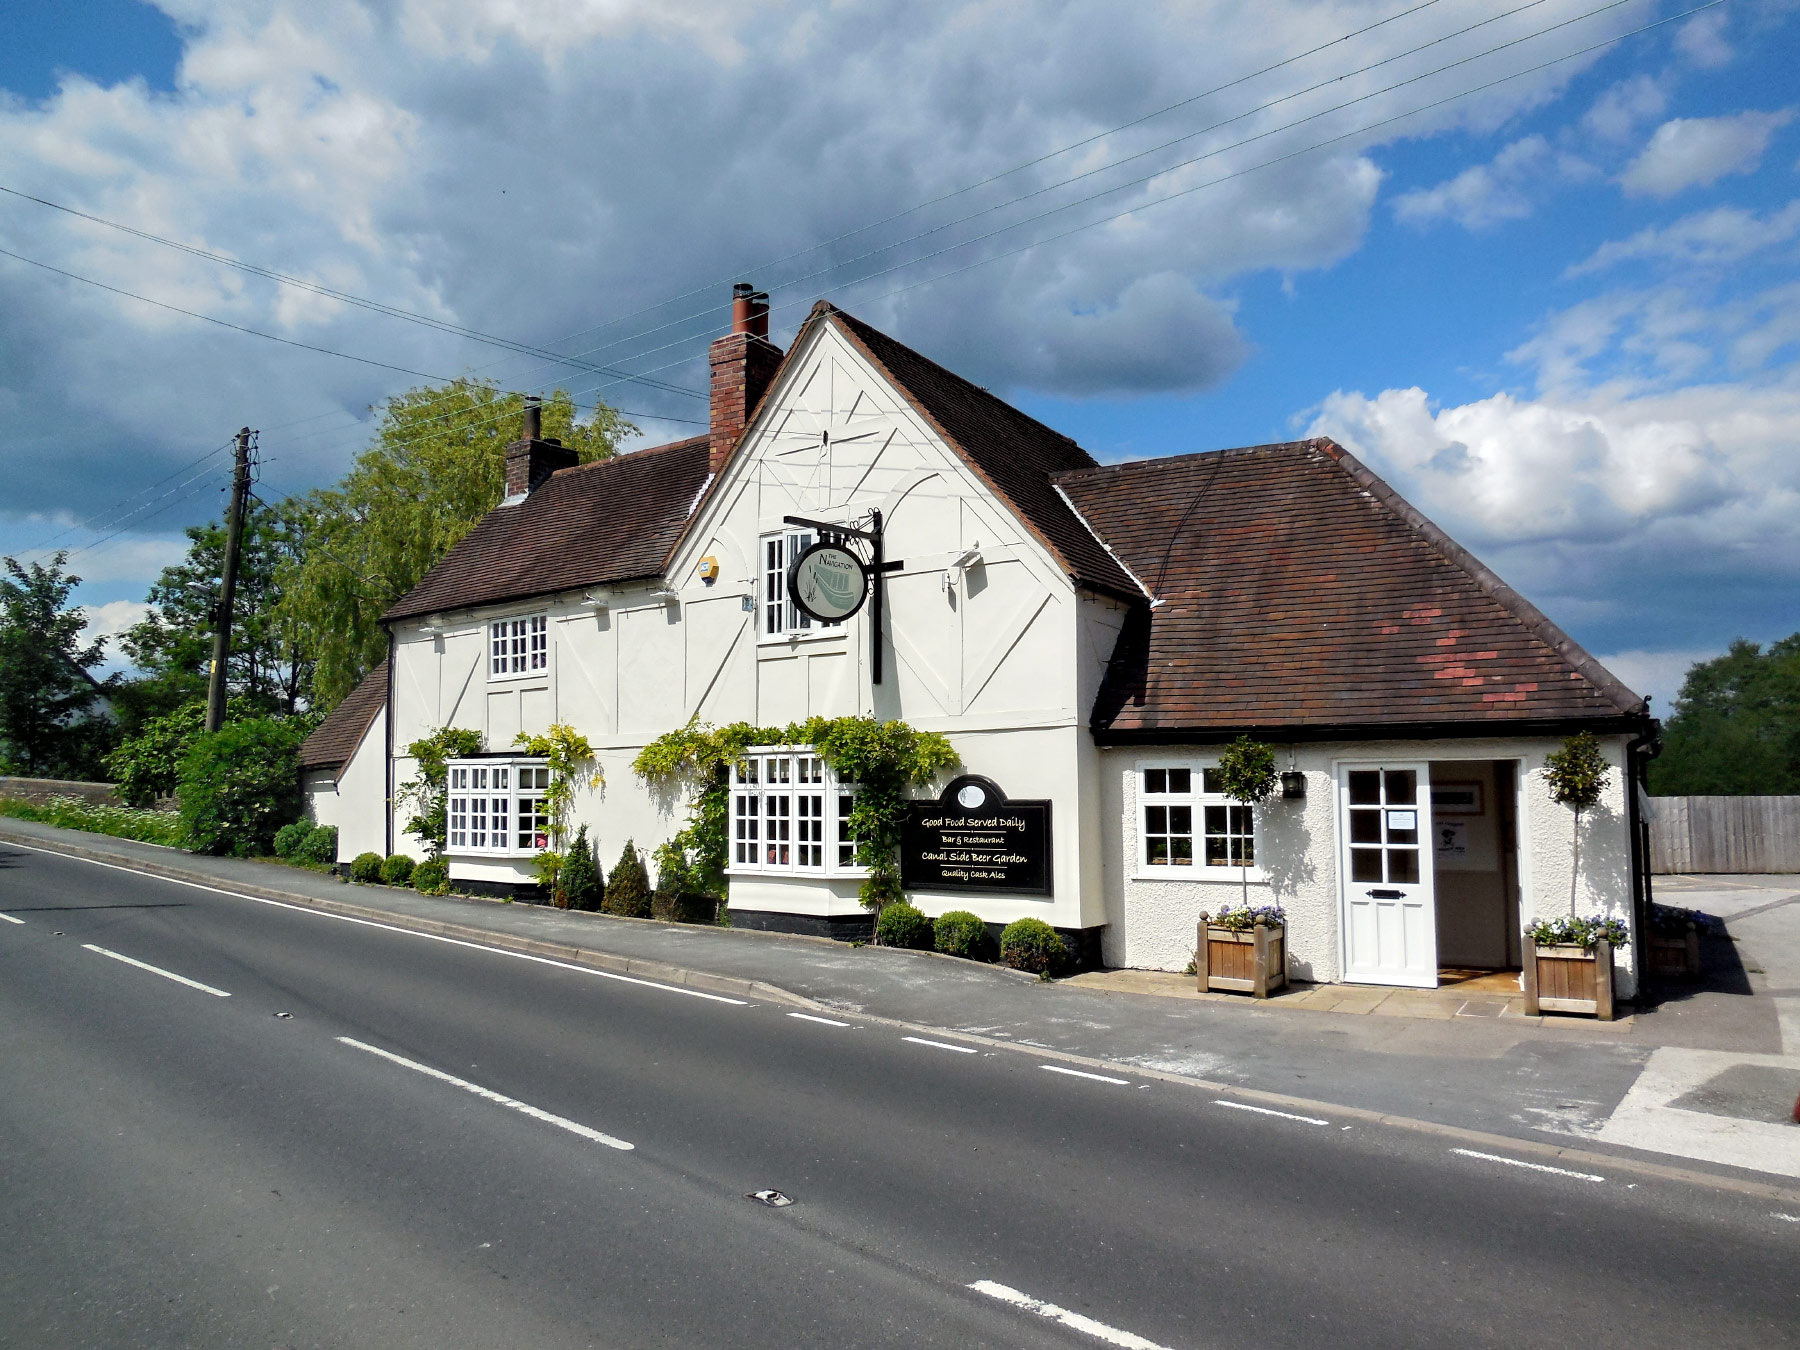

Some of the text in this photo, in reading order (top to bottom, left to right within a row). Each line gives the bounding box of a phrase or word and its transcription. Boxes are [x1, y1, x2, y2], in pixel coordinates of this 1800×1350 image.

[819, 553, 853, 570] NAVIGATION
[922, 816, 1025, 831] Good Food Served Daily
[941, 835, 1004, 845] Bar & Restaurant
[922, 851, 1027, 864] Canal Side Beer Garden
[941, 869, 1005, 880] Quality Cask Ales
